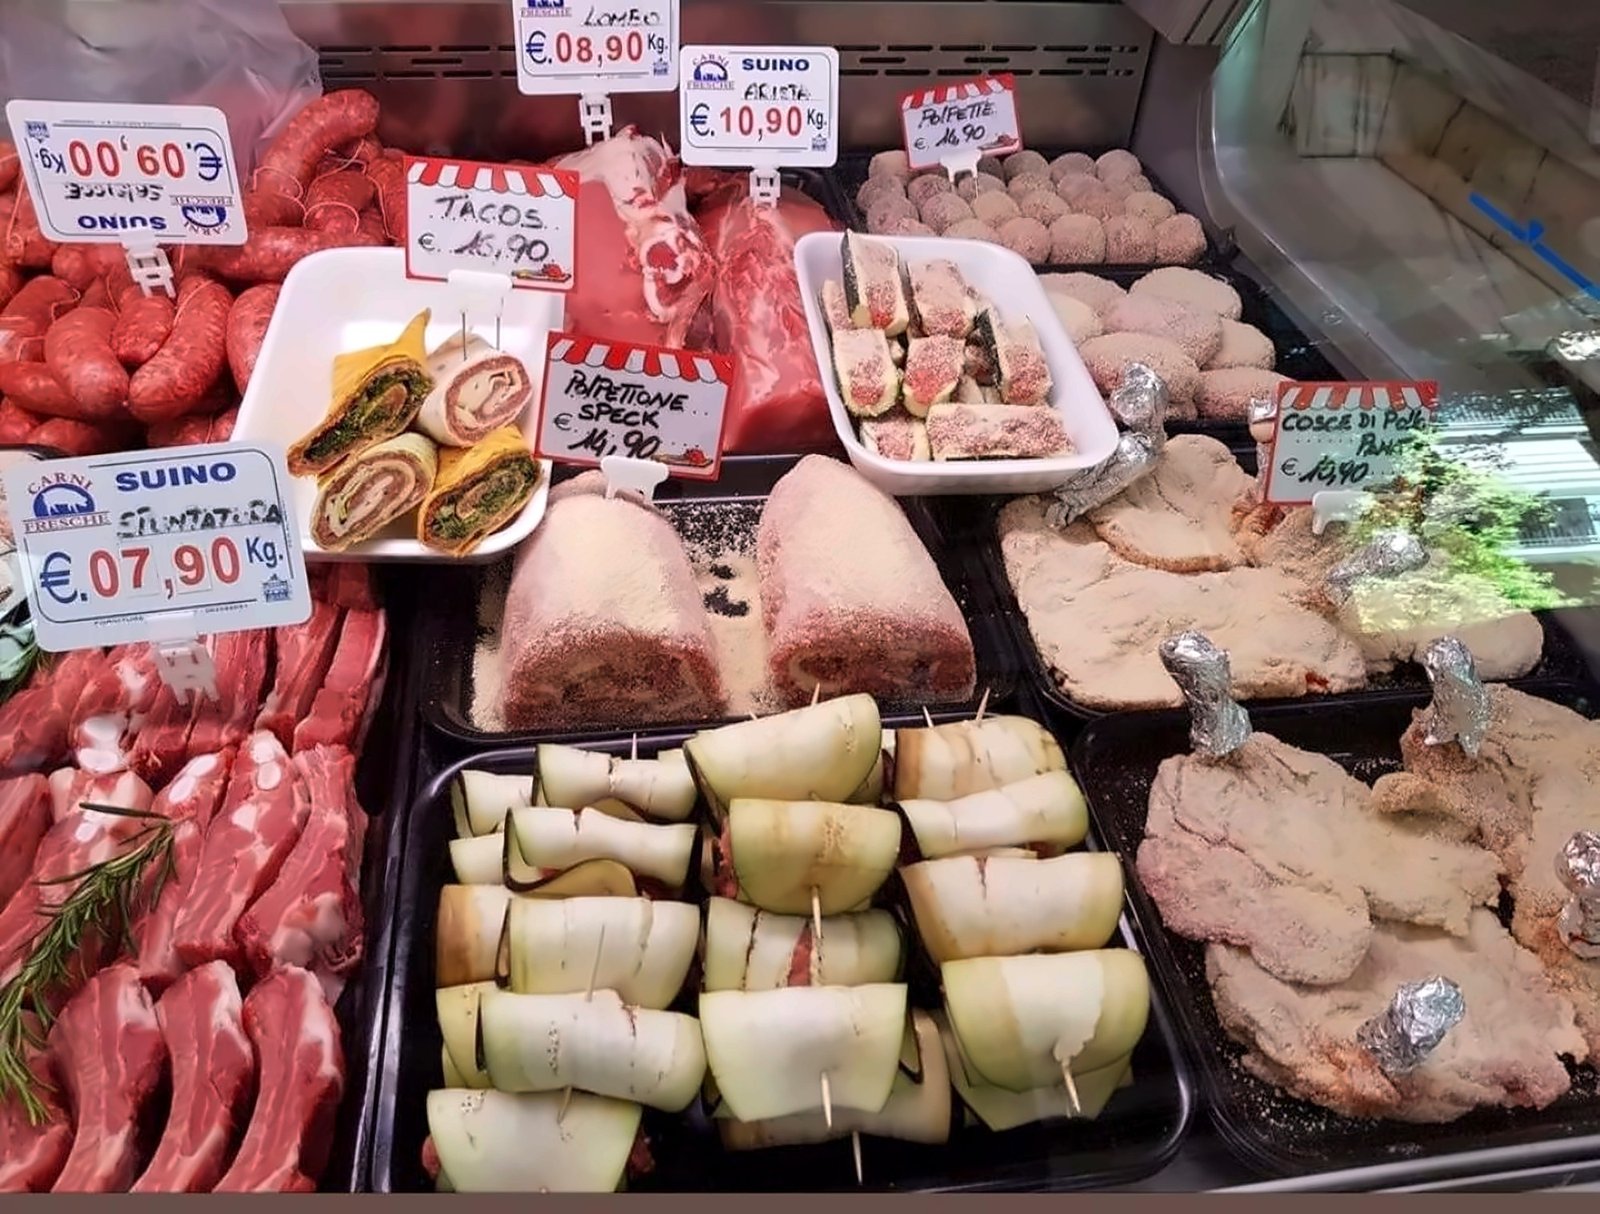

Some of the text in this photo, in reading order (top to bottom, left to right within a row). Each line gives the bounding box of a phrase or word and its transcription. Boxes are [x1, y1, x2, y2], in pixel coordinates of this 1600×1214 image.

[693, 54, 730, 68] CARNI
[742, 59, 810, 71] SUINO
[78, 215, 167, 230] SUINO
[435, 194, 543, 229] TACOS
[578, 402, 660, 429] SPECK
[1282, 413, 1352, 432] COSCE
[1358, 412, 1376, 429] DI
[567, 428, 661, 460] 14,90
[27, 472, 94, 496] CARNI
[115, 462, 237, 492] SUINO
[25, 513, 111, 534] FRESCHE
